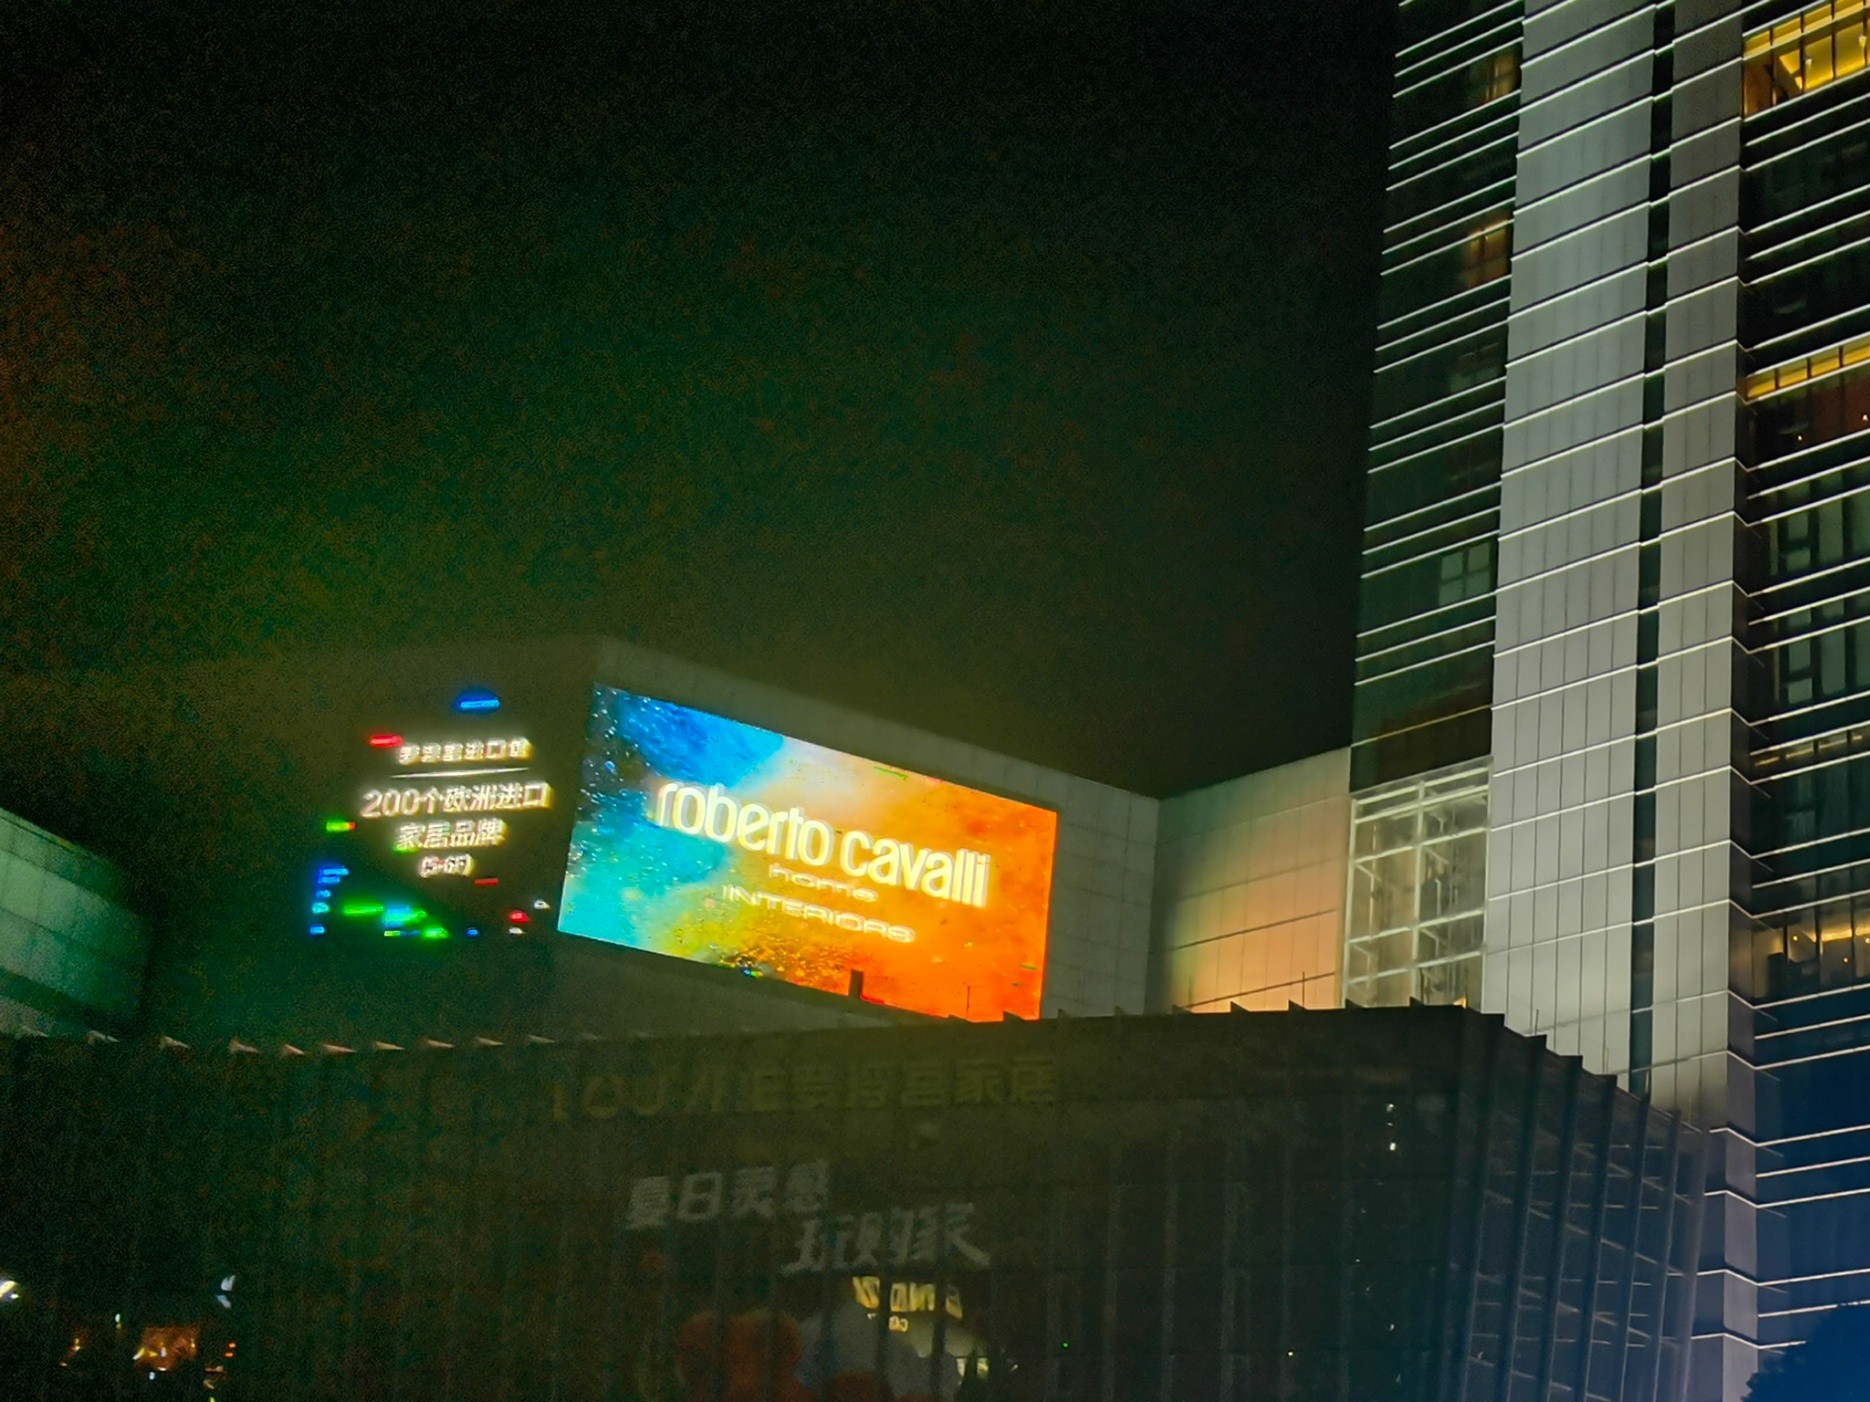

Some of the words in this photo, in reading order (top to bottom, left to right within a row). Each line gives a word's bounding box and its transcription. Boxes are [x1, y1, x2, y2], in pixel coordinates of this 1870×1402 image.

[360, 782, 553, 818] 200个欧洲进口
[395, 818, 507, 850] 家居品牌
[657, 781, 834, 867] roberto
[840, 830, 992, 909] cavalli
[769, 863, 879, 903] home
[722, 884, 916, 944] INTERIORS
